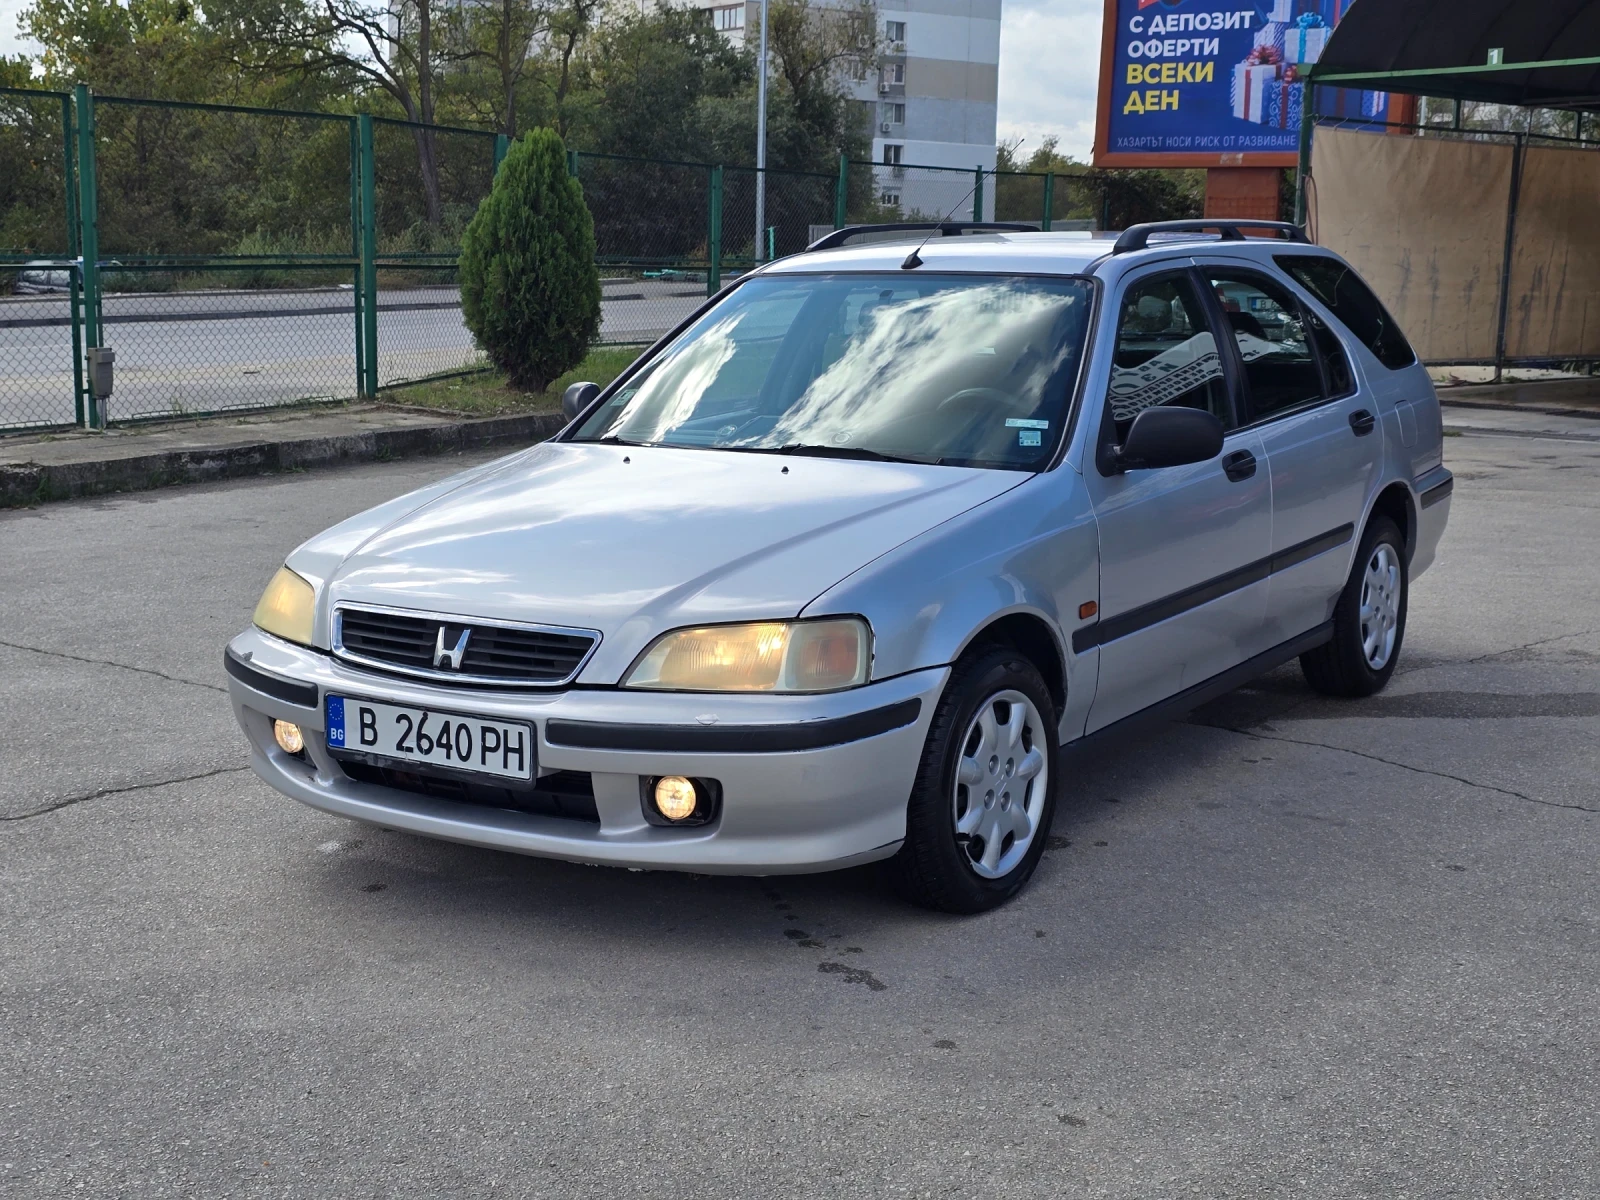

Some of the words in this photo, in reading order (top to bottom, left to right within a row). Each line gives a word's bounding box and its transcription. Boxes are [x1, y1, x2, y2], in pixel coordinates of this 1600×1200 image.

[1129, 15, 1144, 33] С
[1148, 11, 1255, 35] ДЕПОЗИТ
[1127, 38, 1219, 58] ОФЕРТИ
[1489, 48, 1499, 65] 1
[1126, 61, 1213, 85] ВСЕКИ
[1123, 89, 1180, 115] ДЕН
[1117, 136, 1163, 148] ХАЗАРТЪТ
[1166, 136, 1191, 147] НОСИ
[1195, 135, 1220, 147] РИСК
[1223, 135, 1235, 147] ОТ
[1238, 135, 1297, 147] РАЗВИВАНЕ
[330, 727, 344, 741] BG
[358, 706, 378, 747] B
[395, 713, 473, 763] 2640
[480, 725, 525, 772] PH
